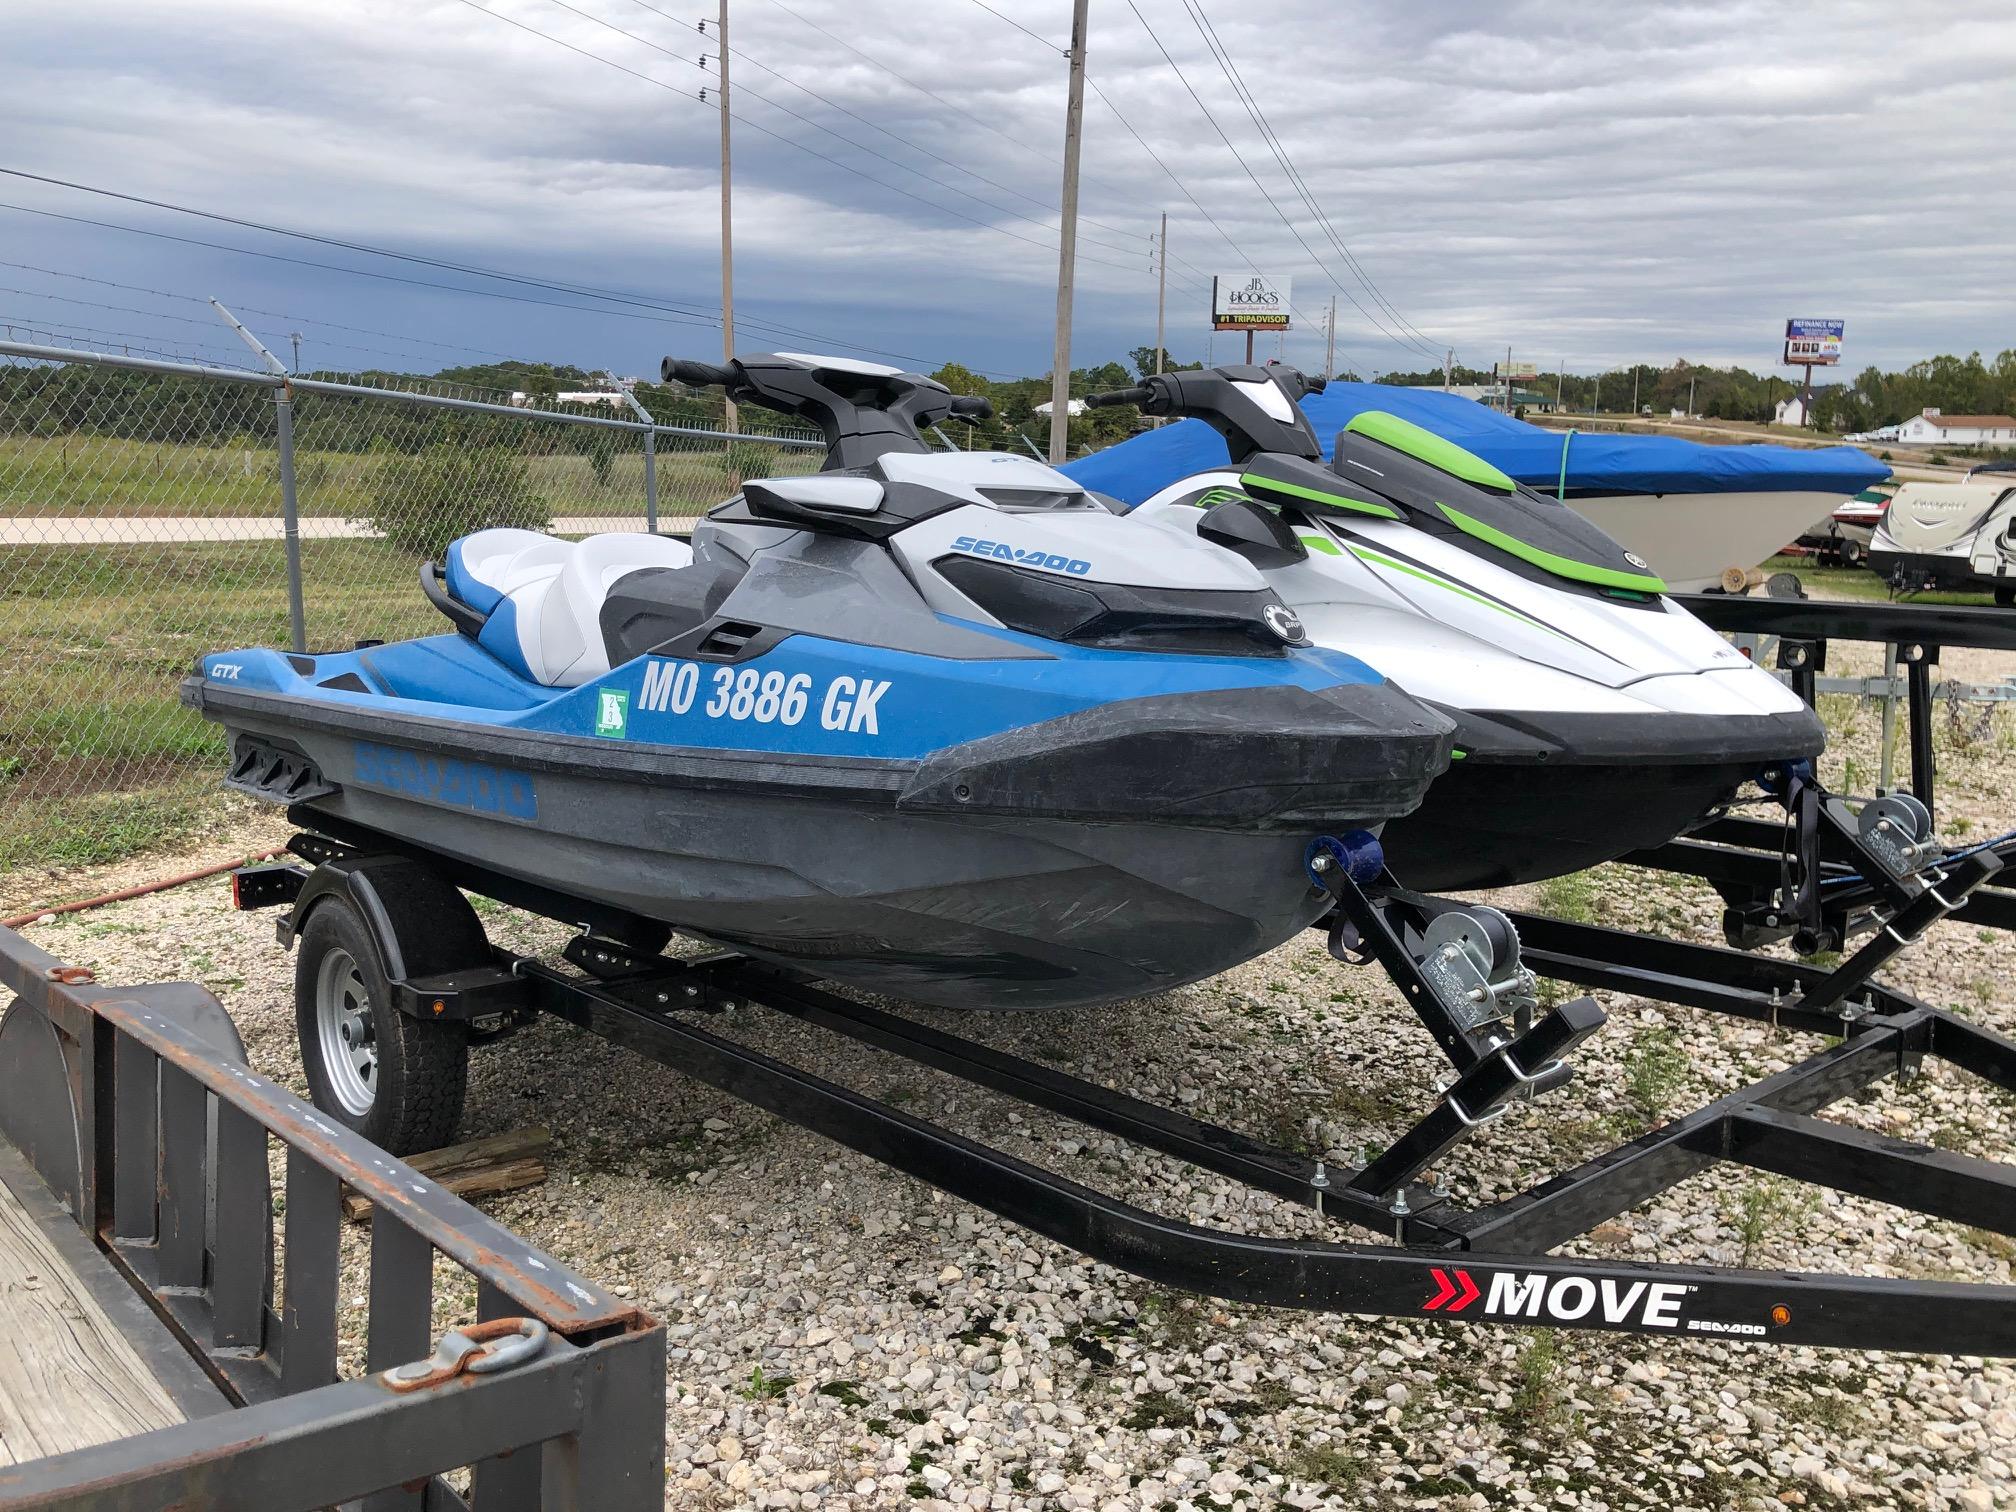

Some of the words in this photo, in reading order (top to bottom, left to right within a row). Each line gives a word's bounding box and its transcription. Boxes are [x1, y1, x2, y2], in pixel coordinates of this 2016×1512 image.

[1247, 278, 1263, 291] JB
[1229, 291, 1279, 304] HOOK'S
[1220, 315, 1230, 323] #1
[1233, 315, 1287, 324] TRIPADVISOR
[211, 664, 243, 680] GTX
[638, 661, 699, 714] MO
[706, 667, 812, 725] 3886
[821, 676, 893, 735] GK
[1484, 1272, 1687, 1327] MOVE
